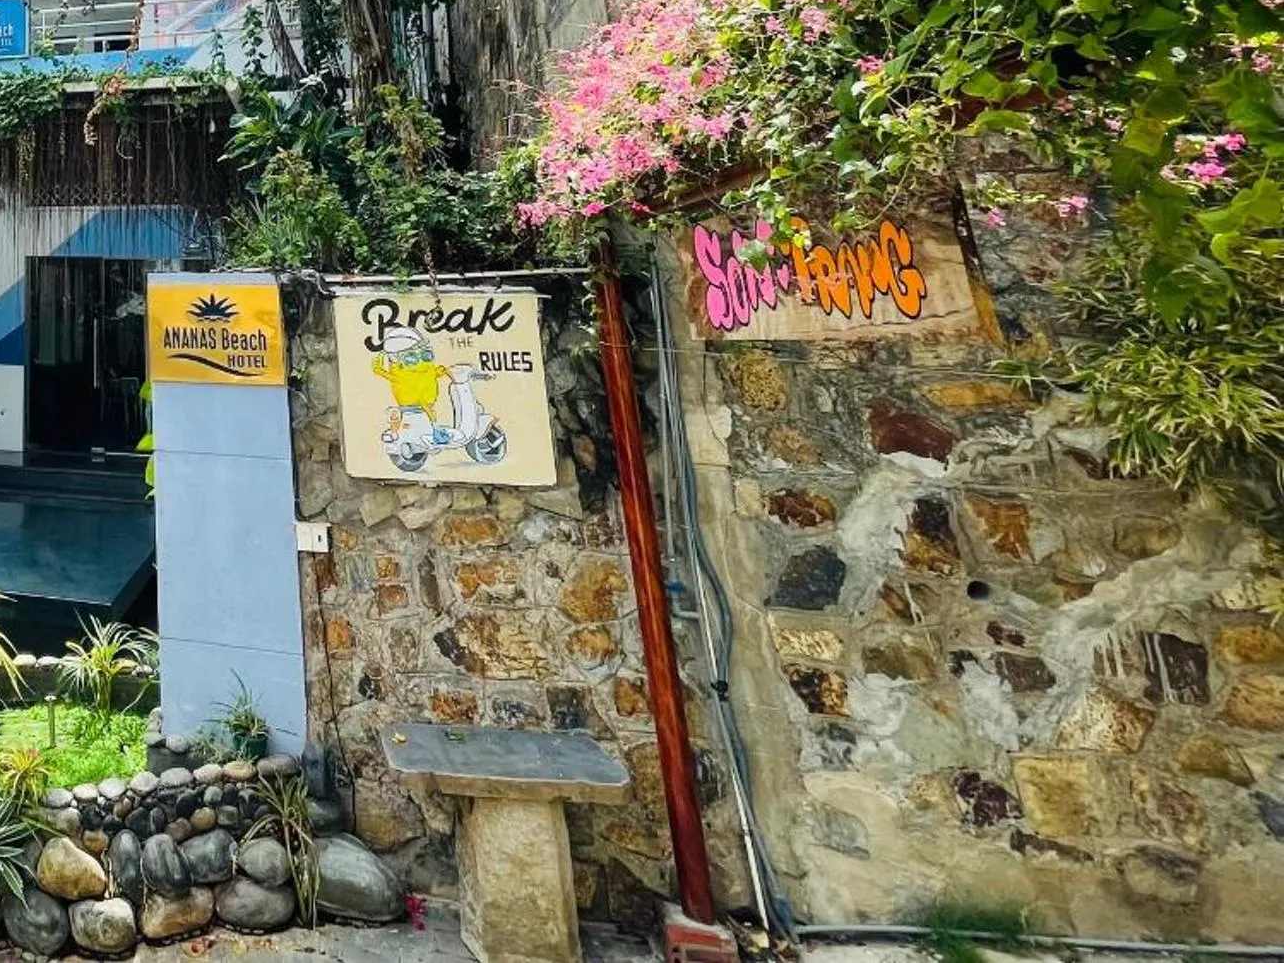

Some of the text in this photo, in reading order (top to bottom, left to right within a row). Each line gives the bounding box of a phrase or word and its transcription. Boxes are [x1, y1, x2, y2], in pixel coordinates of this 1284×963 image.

[362, 298, 515, 352] Break
[163, 326, 267, 352] ANANAS Beach
[449, 338, 476, 351] THE
[227, 355, 266, 368] HOTEL
[479, 351, 534, 373] RULES
